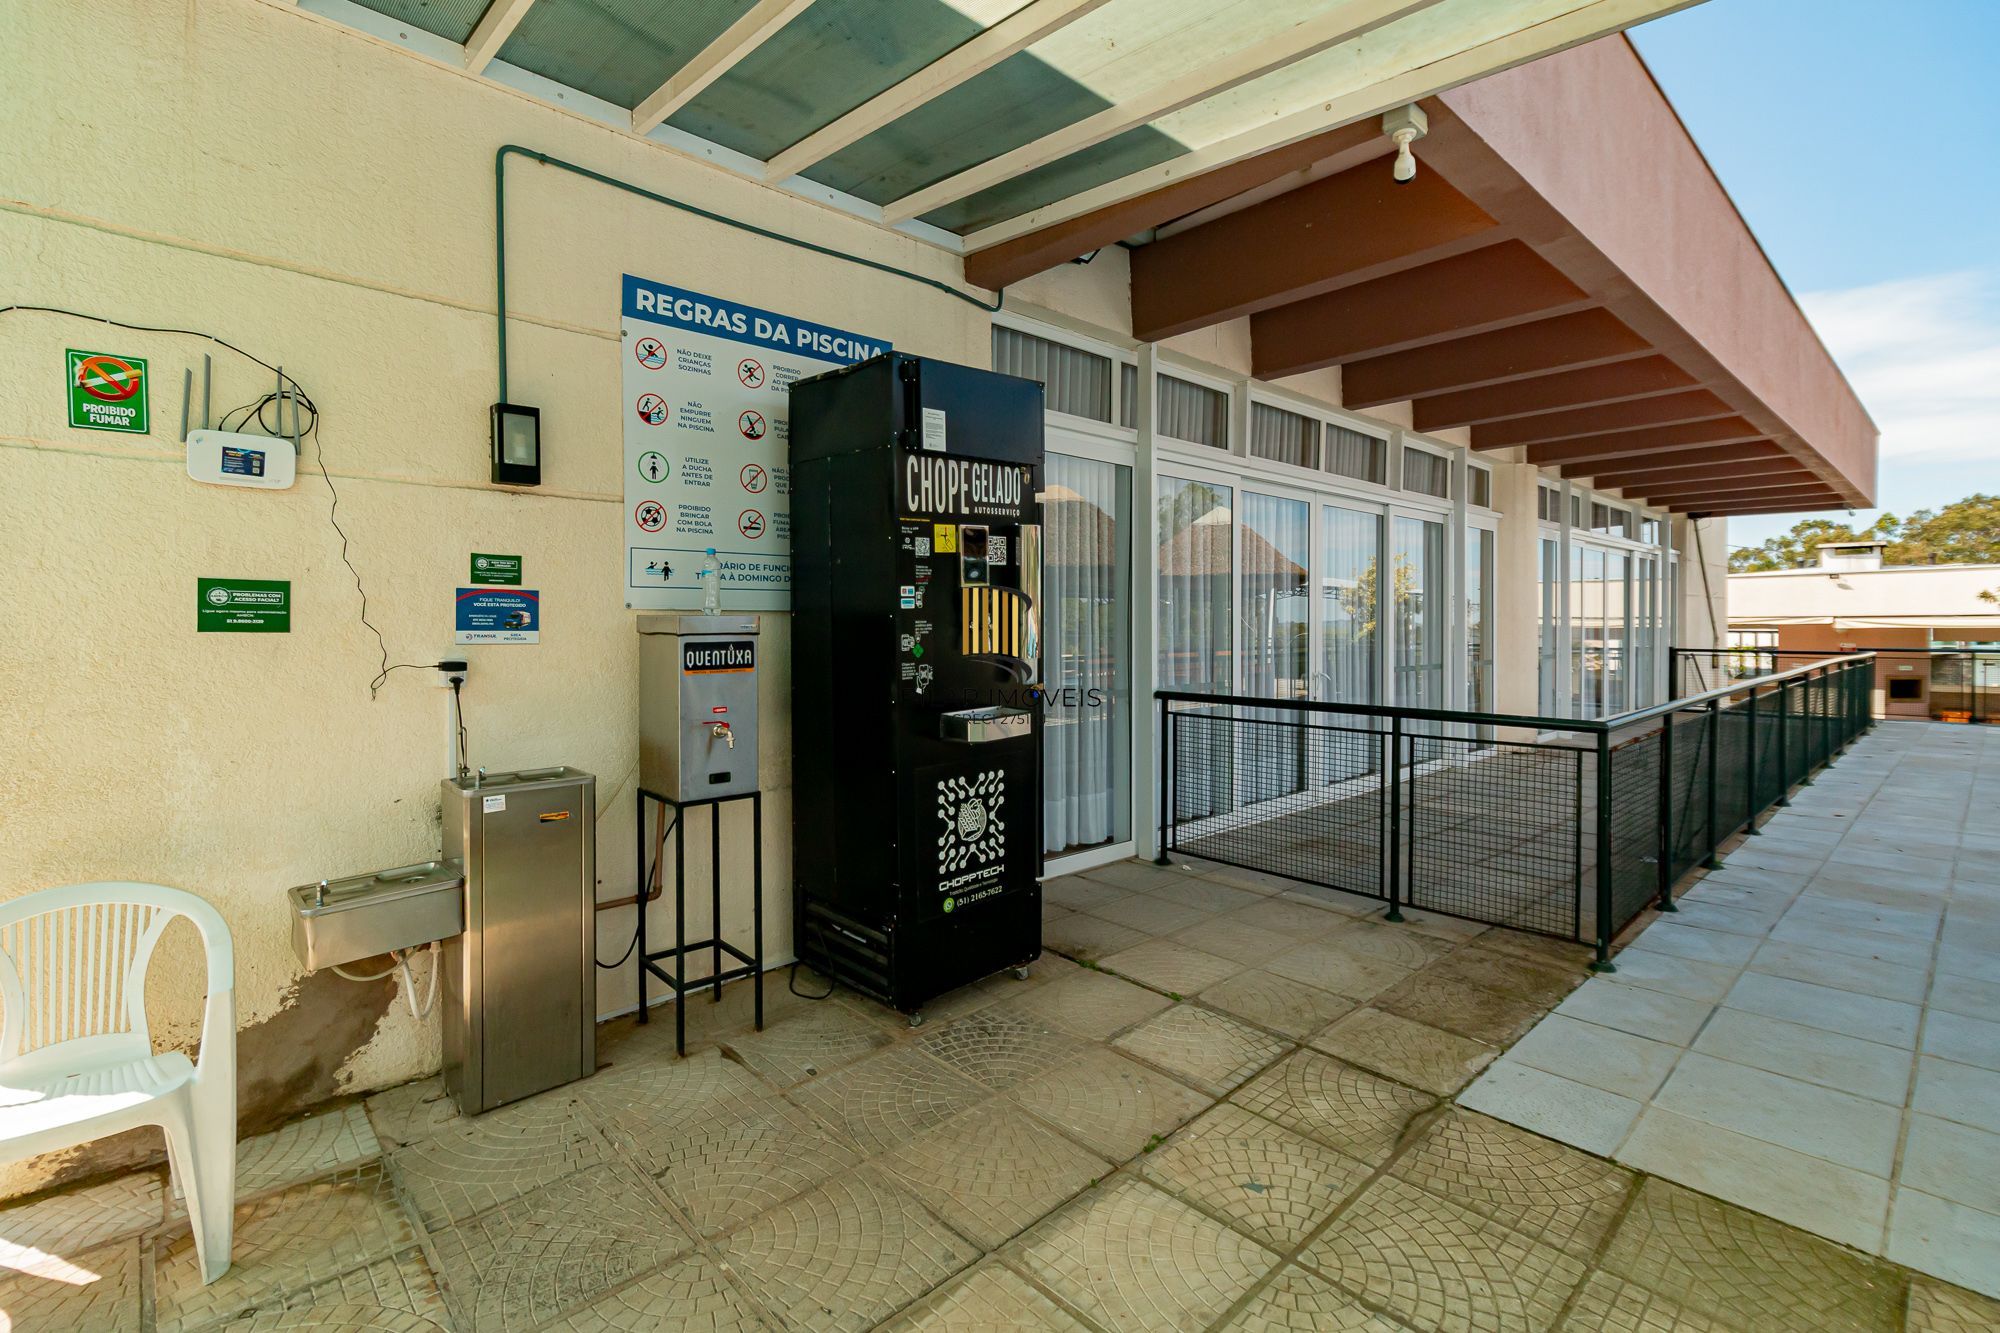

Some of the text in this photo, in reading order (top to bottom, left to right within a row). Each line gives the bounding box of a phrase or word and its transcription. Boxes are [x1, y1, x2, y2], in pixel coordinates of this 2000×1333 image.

[636, 287, 882, 361] REGRAS DA PISCINA
[677, 348, 712, 361] NÃO DEIXE
[678, 356, 712, 369] CRIANÇAS
[678, 364, 712, 376] SOZINHAS
[773, 365, 801, 375] PROIBIDO
[687, 401, 702, 409] NÃO
[82, 403, 136, 418] PROIBIDO
[680, 407, 711, 418] EMPURRE
[89, 413, 130, 427] FUMAR
[689, 424, 715, 433] PISCINA
[685, 457, 709, 465] UTILIZE
[689, 464, 712, 473] DUCHA
[681, 471, 703, 479] ANTES
[684, 479, 711, 487] ENTRAR
[906, 454, 1021, 515] CHOPE GELADO
[678, 504, 711, 513] PROIBIDO
[974, 506, 1020, 518] AUTOSSERVIÇO
[680, 512, 709, 520] BRINCAR
[688, 527, 714, 535] PISCINA
[720, 561, 790, 572] RÁRIO DE FUNCI
[738, 573, 782, 583] DOMINGO
[939, 864, 1005, 891] CHOPPTECH
